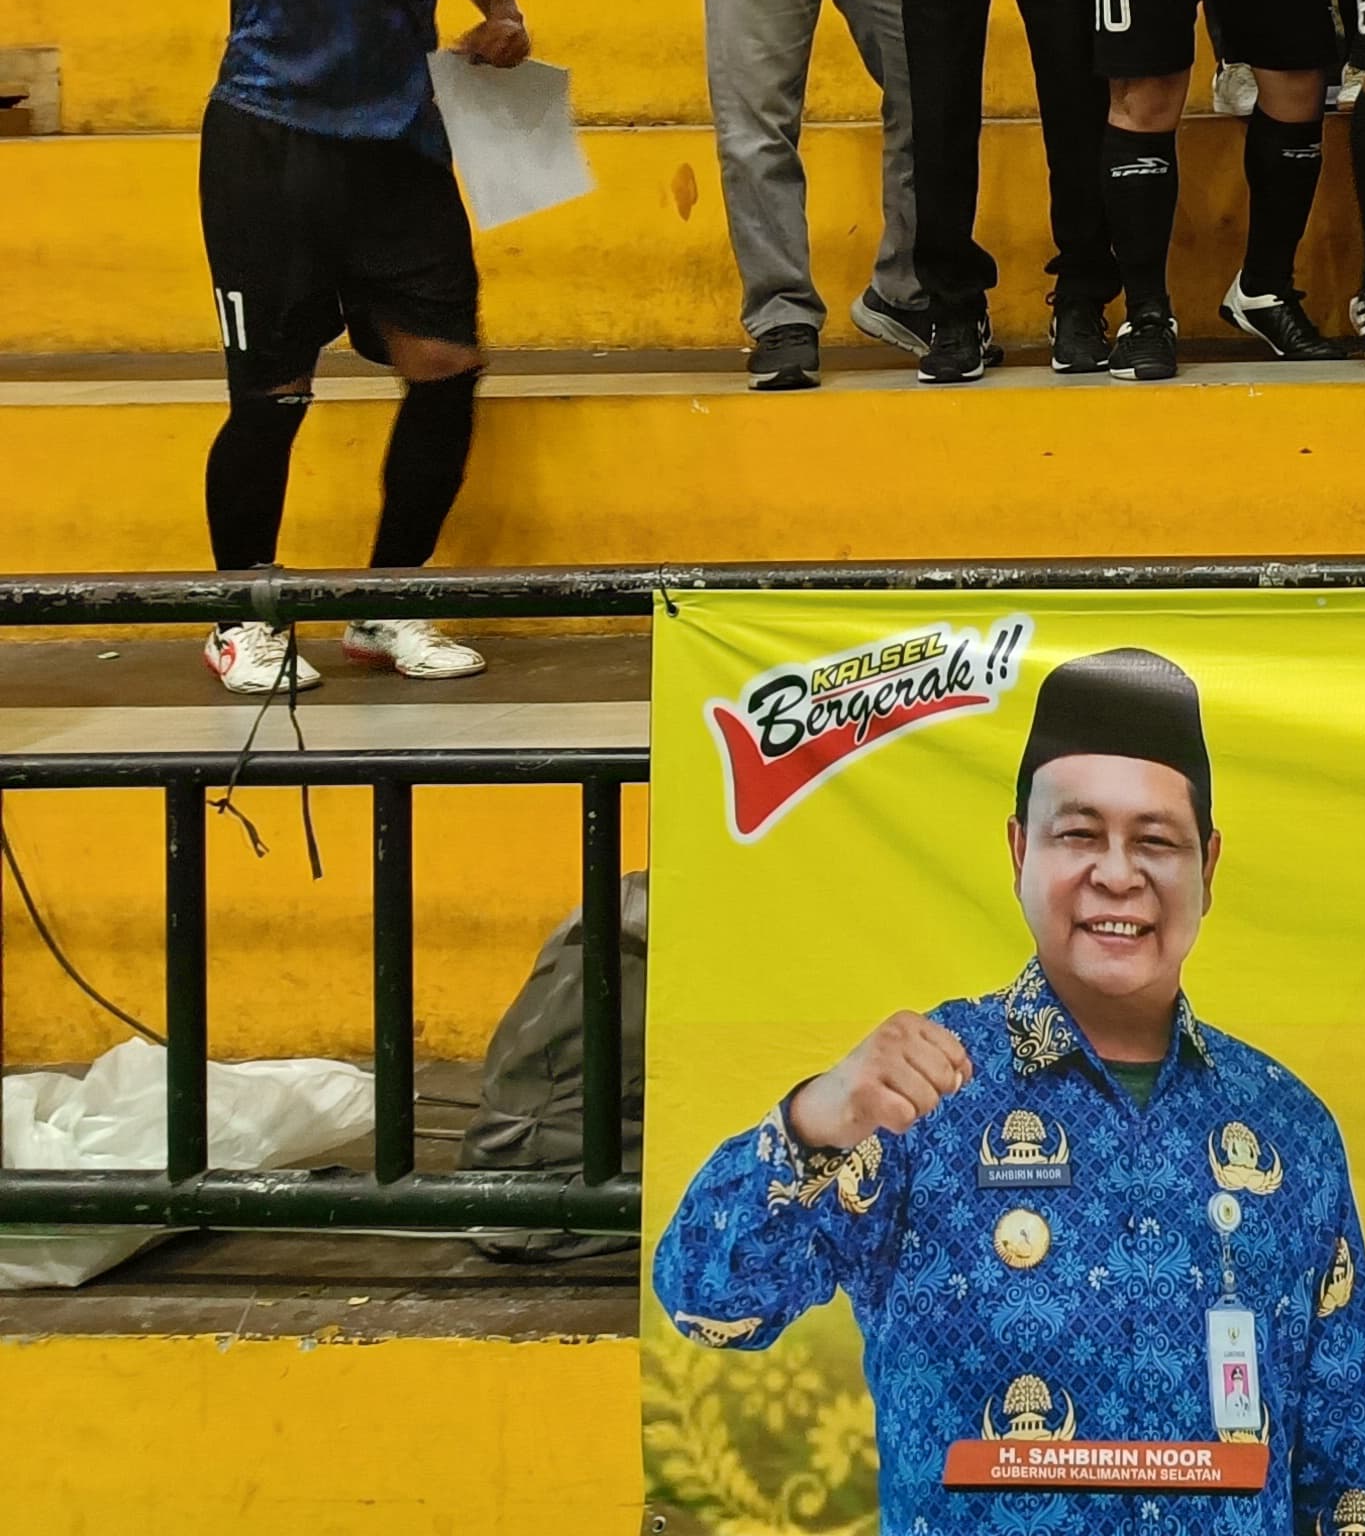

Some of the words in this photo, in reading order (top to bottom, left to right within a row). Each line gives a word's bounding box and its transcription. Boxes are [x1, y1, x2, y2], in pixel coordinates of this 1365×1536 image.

[213, 287, 249, 353] 11
[811, 632, 948, 696] KALSEL
[749, 639, 975, 758] Bergerak
[988, 1170, 1033, 1181] SAHBIRIN
[1035, 1169, 1062, 1180] NOOR
[991, 1466, 1066, 1478] GUBERNUR
[1070, 1467, 1158, 1480] KALIMANTAN
[1160, 1469, 1221, 1481] SELATAN
[999, 1448, 1022, 1464] H.
[1028, 1448, 1139, 1466] SAHBIRIN
[1145, 1449, 1212, 1466] NOOR
